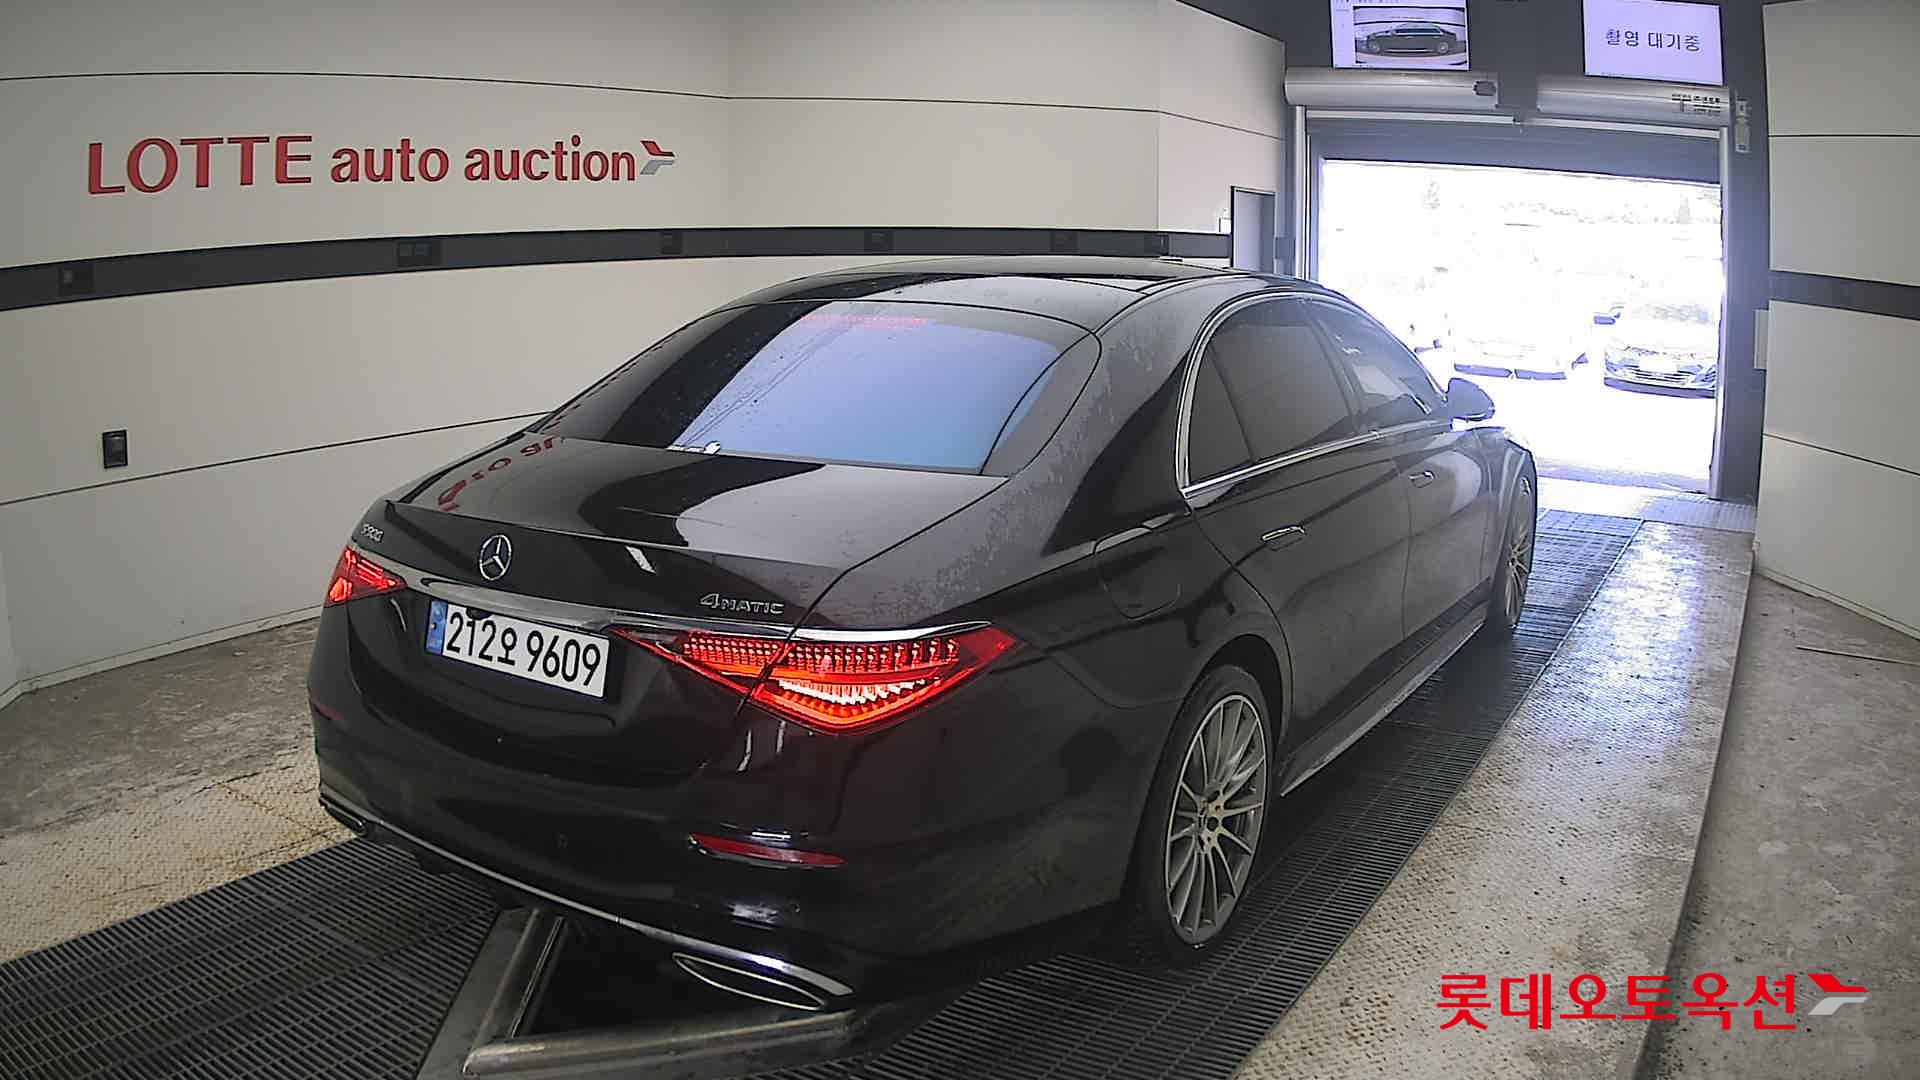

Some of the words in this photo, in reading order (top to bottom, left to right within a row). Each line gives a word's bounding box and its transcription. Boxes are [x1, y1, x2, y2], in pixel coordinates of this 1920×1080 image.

[1648, 32, 1700, 52] 대기중
[88, 135, 312, 195] LOTTE
[330, 138, 449, 183] auto
[464, 134, 637, 182] auction
[700, 593, 785, 614] 4MATIC
[526, 630, 601, 687] 9609
